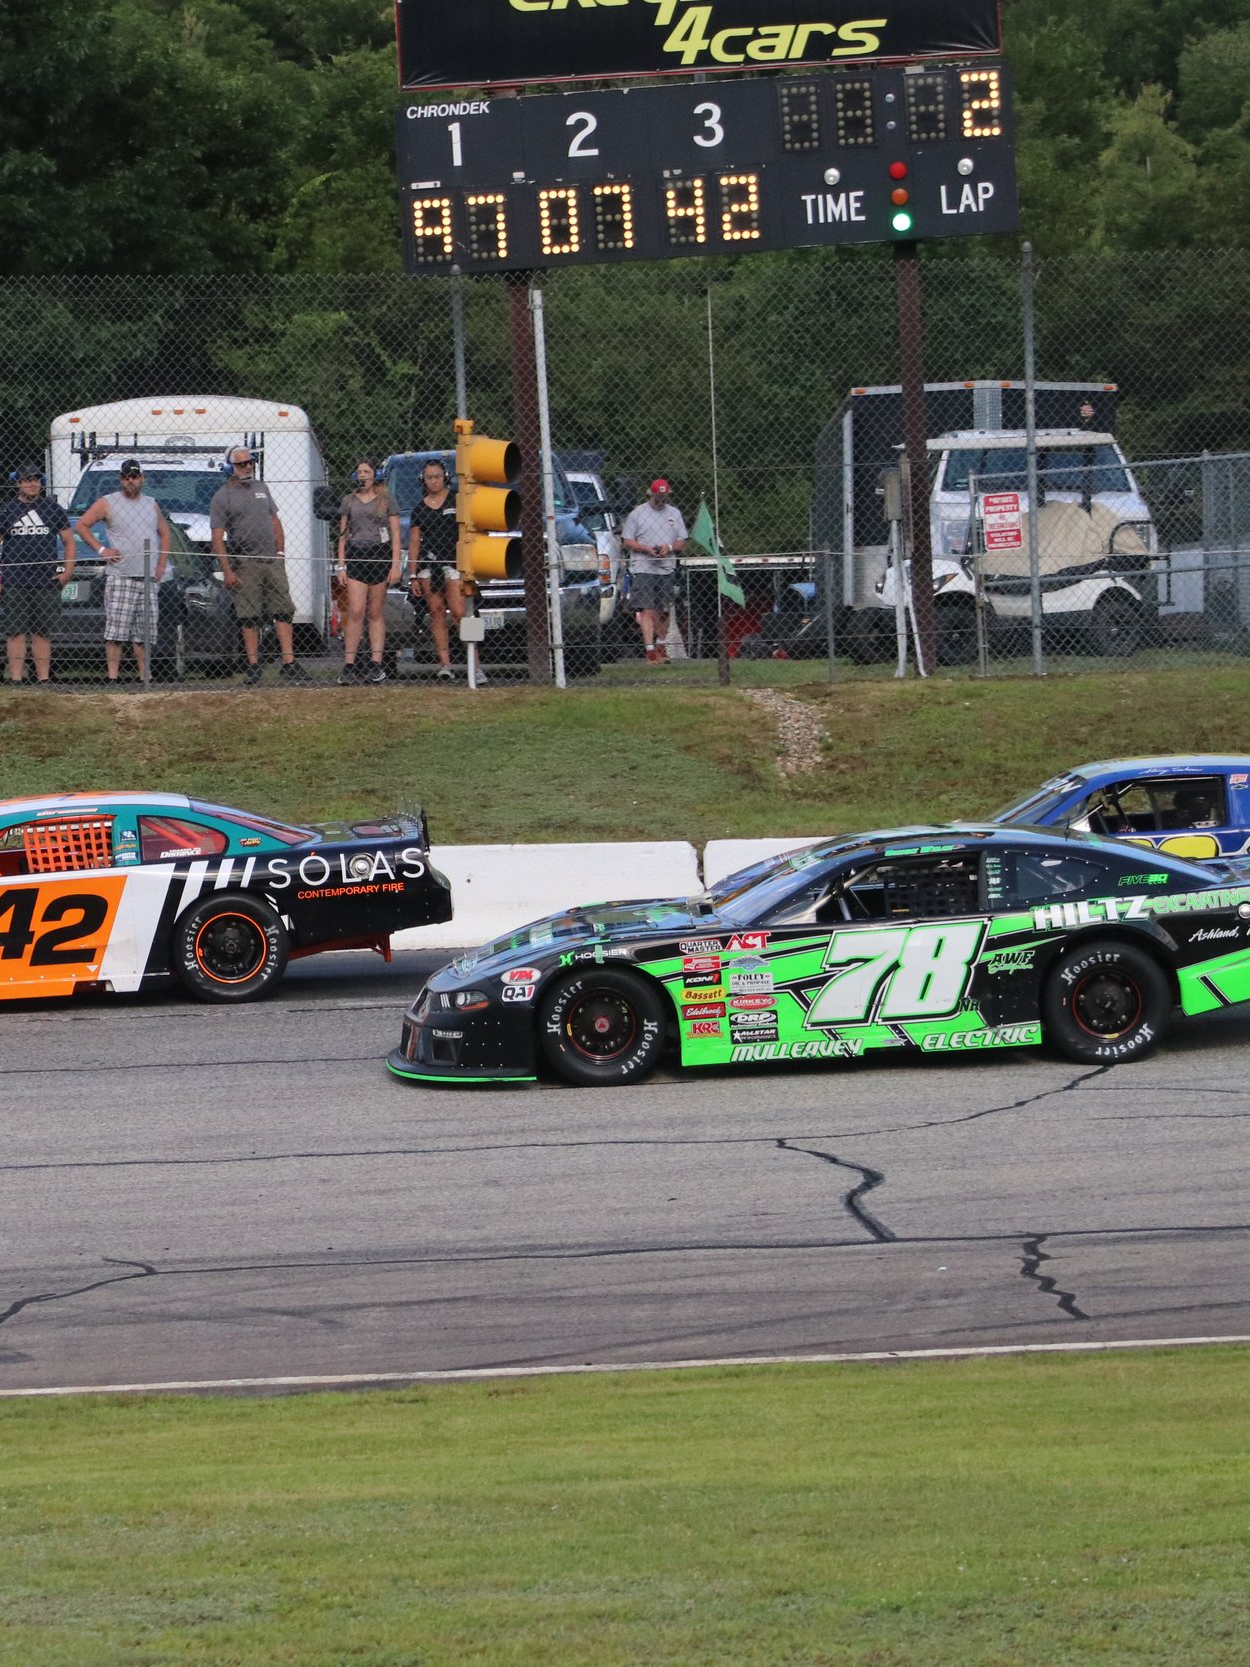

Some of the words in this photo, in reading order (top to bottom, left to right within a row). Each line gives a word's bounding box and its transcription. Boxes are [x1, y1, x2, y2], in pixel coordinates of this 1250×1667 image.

[662, 5, 888, 65] 4cars
[406, 101, 491, 119] CHRONDEK
[959, 71, 1002, 138] 2
[566, 112, 600, 158] 2
[692, 102, 725, 148] 3
[448, 122, 463, 167] 1
[666, 175, 761, 244] 42
[801, 191, 867, 226] TIME
[940, 182, 995, 215] LAP
[538, 184, 634, 254] 07
[10, 526, 50, 536] adidas
[297, 884, 380, 900] CONTEMPORARY
[382, 882, 405, 892] FIRE
[1033, 894, 1150, 931] HILTZ
[184, 916, 202, 971] Hoosier
[680, 940, 718, 951] QUARTER
[687, 945, 723, 954] MASTER
[1188, 926, 1240, 943] Ashland,
[260, 925, 280, 980] Hoosier
[1060, 951, 1121, 985] Hoosier
[685, 976, 713, 984] KONI
[737, 973, 765, 981] FOLEY
[806, 919, 988, 1028] 78
[503, 985, 533, 1000] QA1
[546, 980, 582, 1035] Hoosier
[685, 989, 722, 1000] Bassett
[686, 1006, 721, 1017] Edelbrock
[692, 1021, 719, 1034] KRC
[738, 1013, 770, 1022] DRP
[621, 1018, 658, 1075] Hoosier
[730, 1038, 863, 1062] MULLEAVEY
[921, 1025, 1039, 1051] ELECTRIC
[1094, 1023, 1154, 1059] Hoosier
